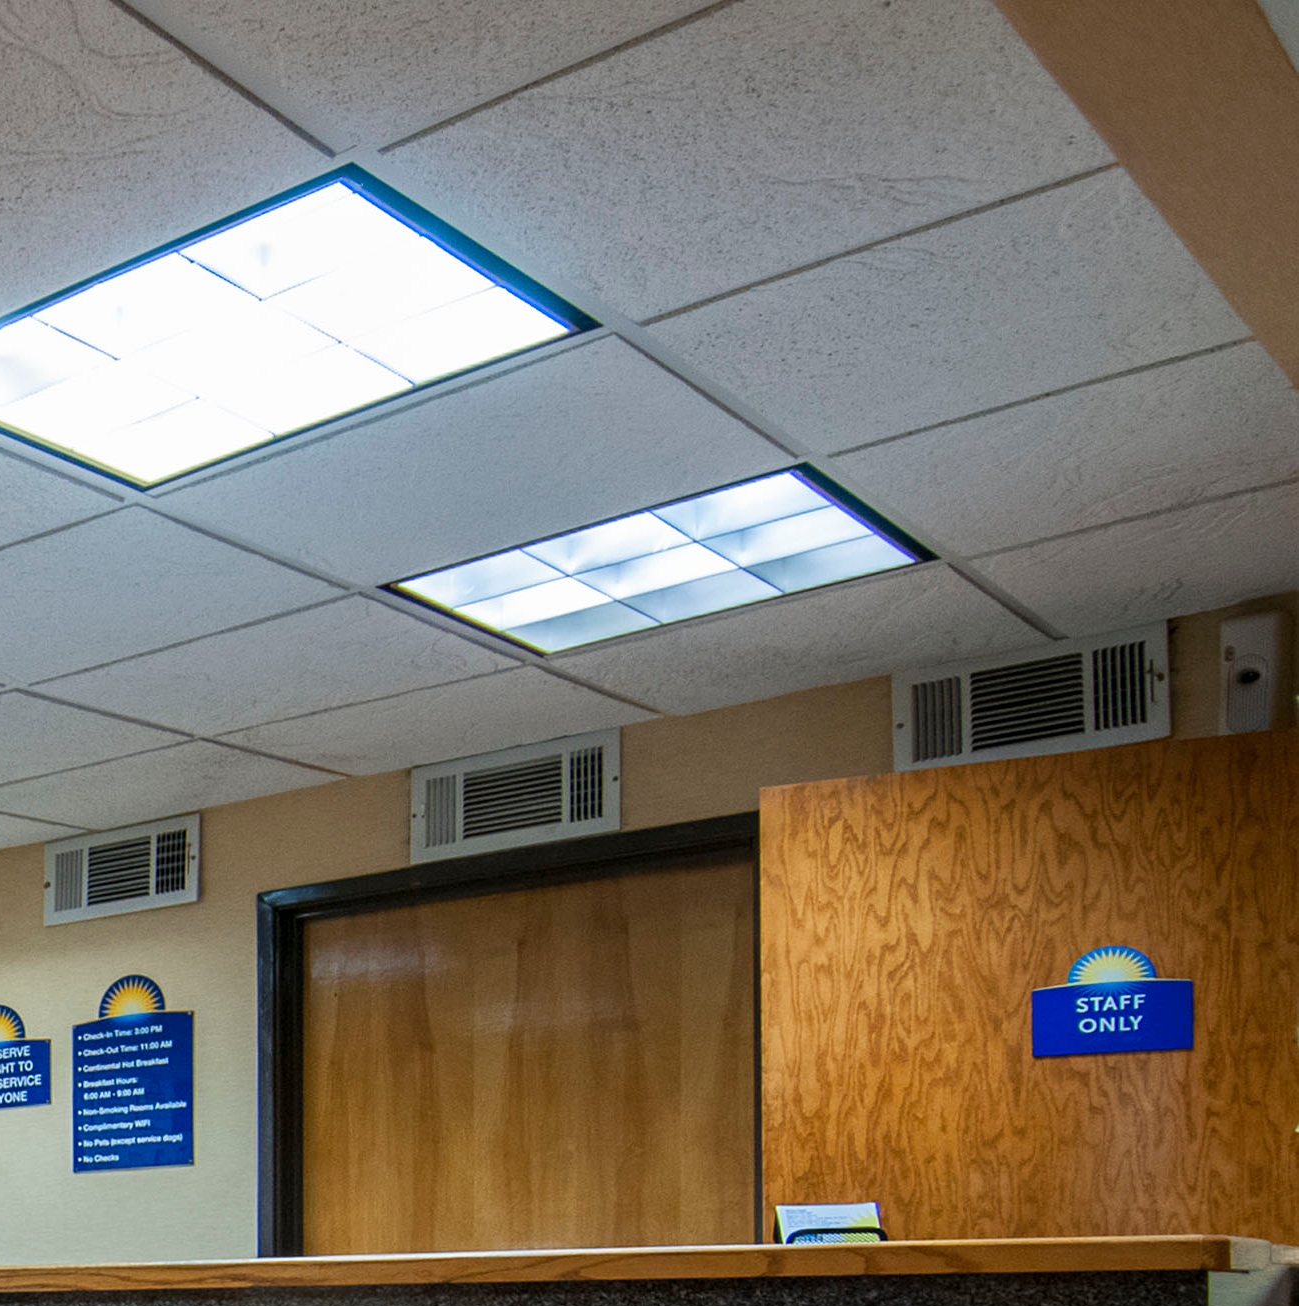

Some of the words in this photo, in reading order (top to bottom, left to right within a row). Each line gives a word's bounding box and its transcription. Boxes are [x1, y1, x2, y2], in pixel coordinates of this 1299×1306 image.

[1075, 994, 1146, 1013] STAFF
[1078, 1015, 1143, 1033] ONLY
[83, 1032, 113, 1041] Check-In
[150, 1025, 163, 1033] PM
[83, 1046, 119, 1056] Check-Out
[140, 1042, 159, 1050] 11:00
[160, 1040, 172, 1048] AM
[18, 1060, 33, 1071] TO
[83, 1062, 120, 1072] Continental
[136, 1057, 169, 1067] Breakfast
[83, 1078, 115, 1088] Breakfast
[99, 1091, 111, 1099] AM
[132, 1088, 145, 1096] AM
[83, 1106, 128, 1116] Non-Smoking
[129, 1104, 154, 1112] Rooms
[155, 1100, 187, 1110] Available
[83, 1122, 133, 1132] Complimentary
[83, 1140, 93, 1148] No
[94, 1139, 109, 1147] Pets
[137, 1135, 161, 1144] service
[94, 1154, 119, 1163] Checks
